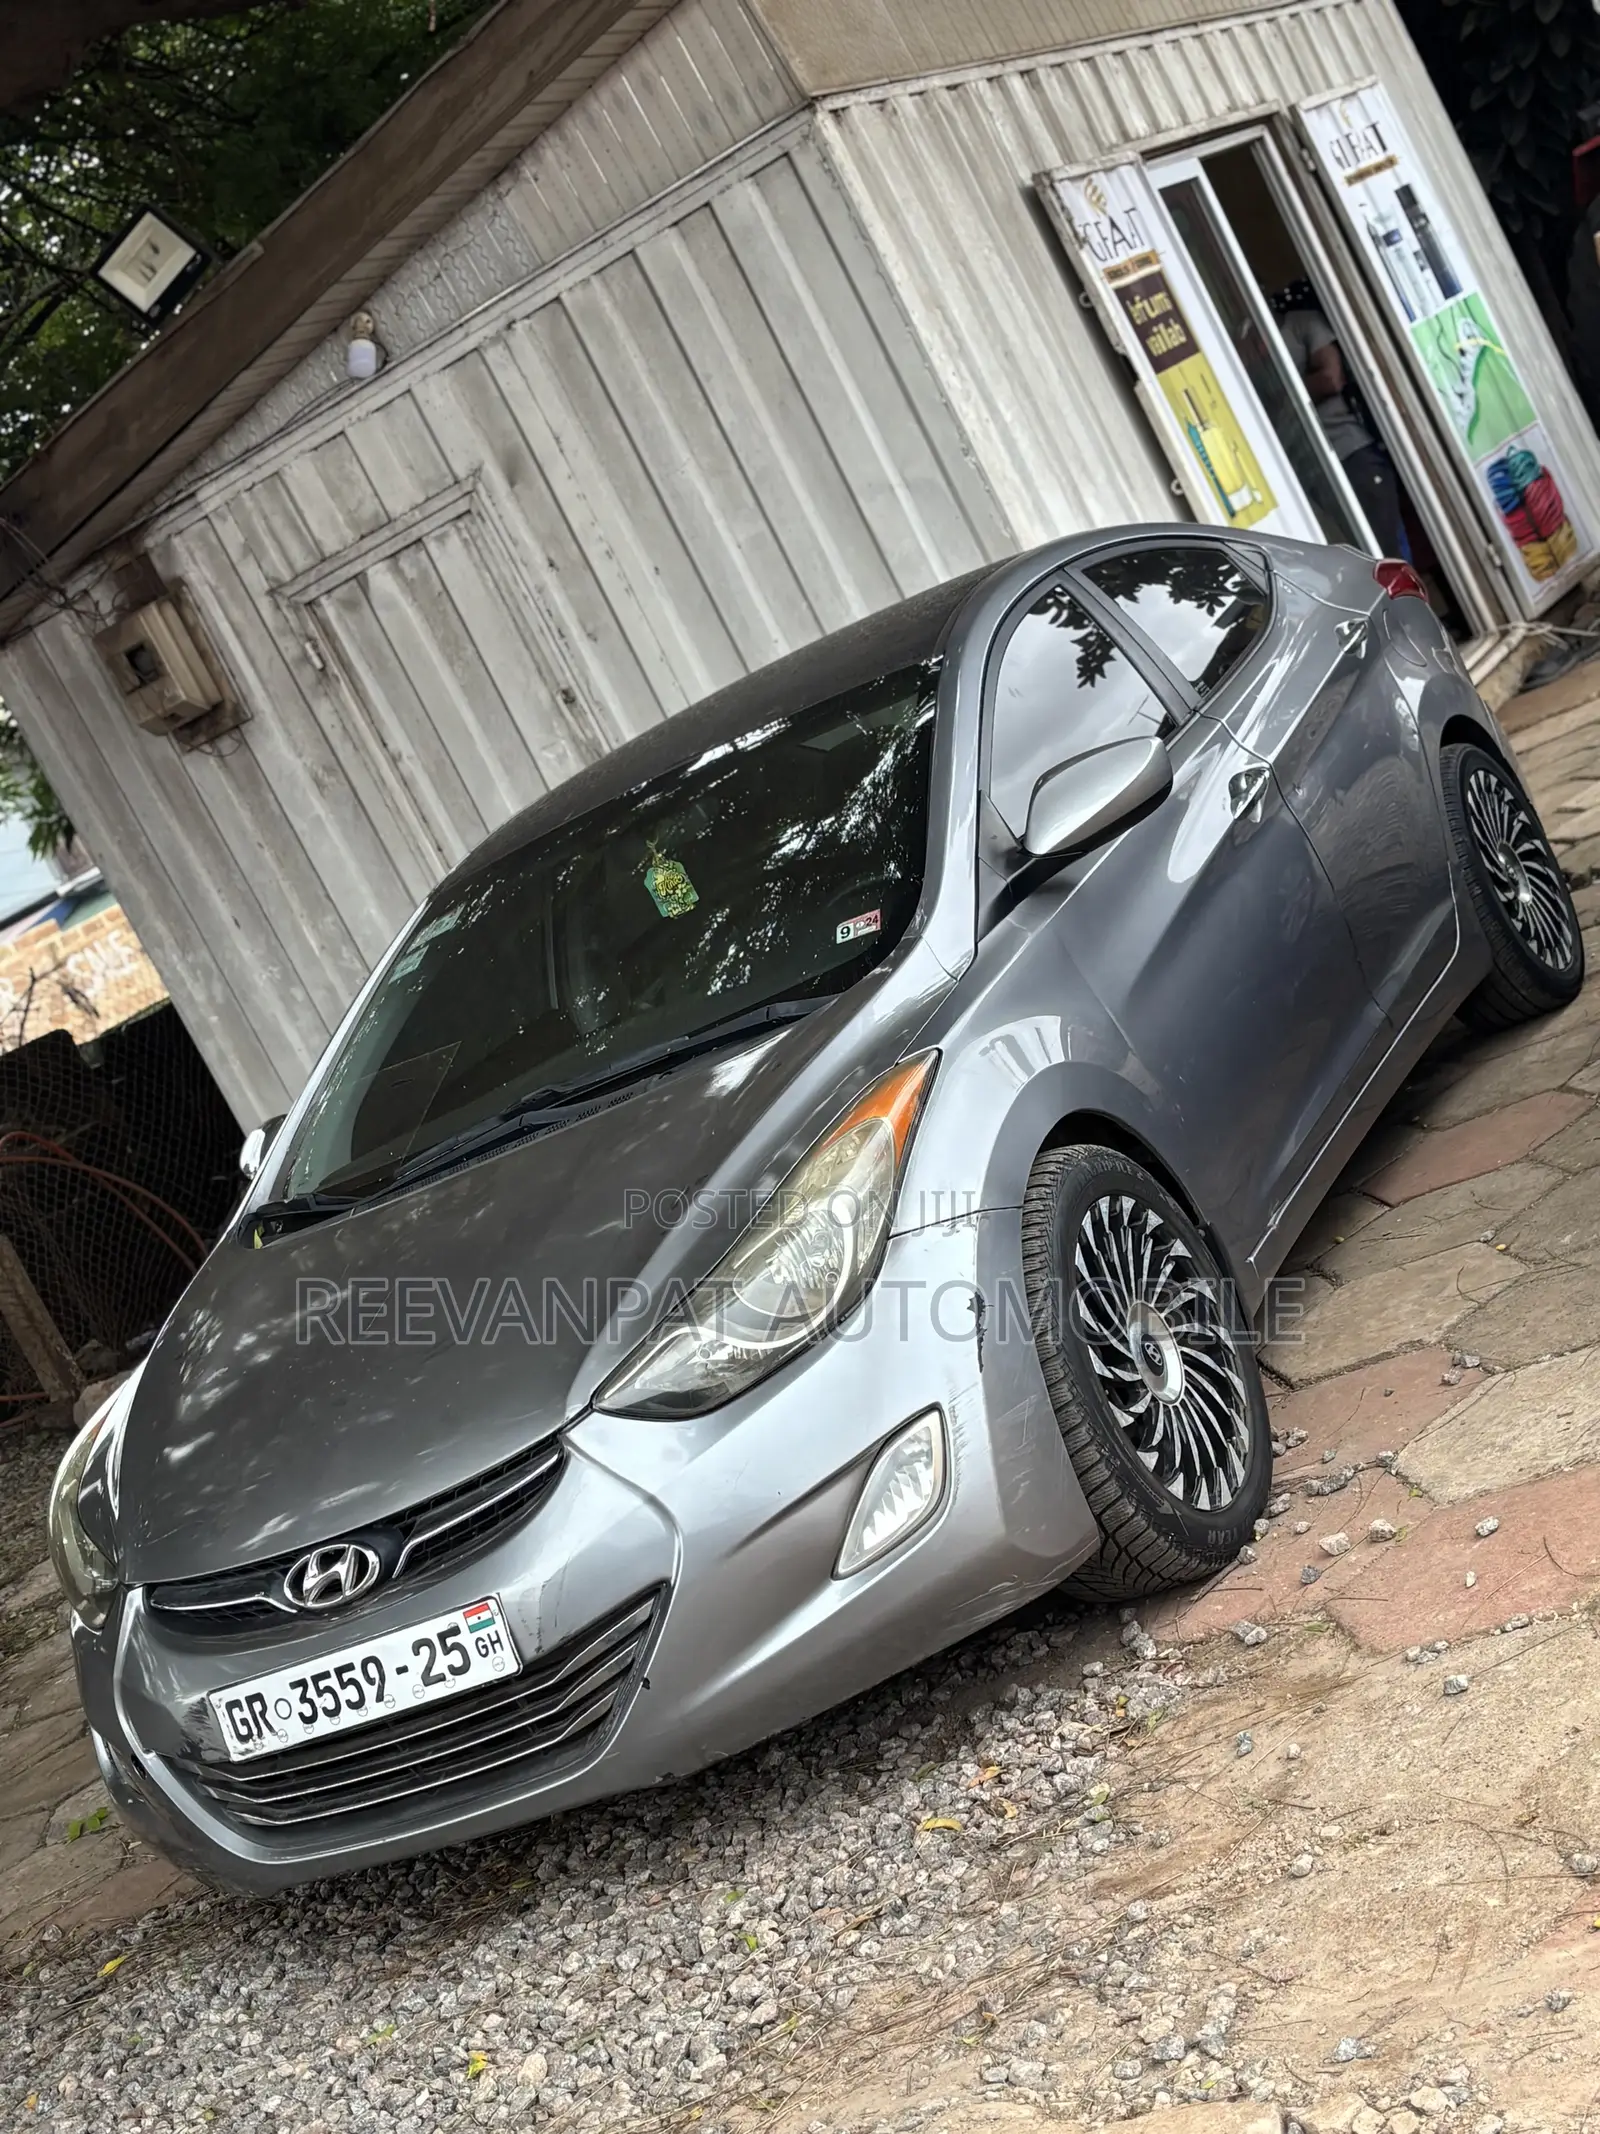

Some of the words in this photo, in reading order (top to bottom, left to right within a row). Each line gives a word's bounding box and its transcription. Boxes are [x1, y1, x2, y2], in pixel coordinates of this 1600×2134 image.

[840, 926, 851, 940] 9
[475, 1630, 504, 1658] GH
[225, 1692, 277, 1744] GR
